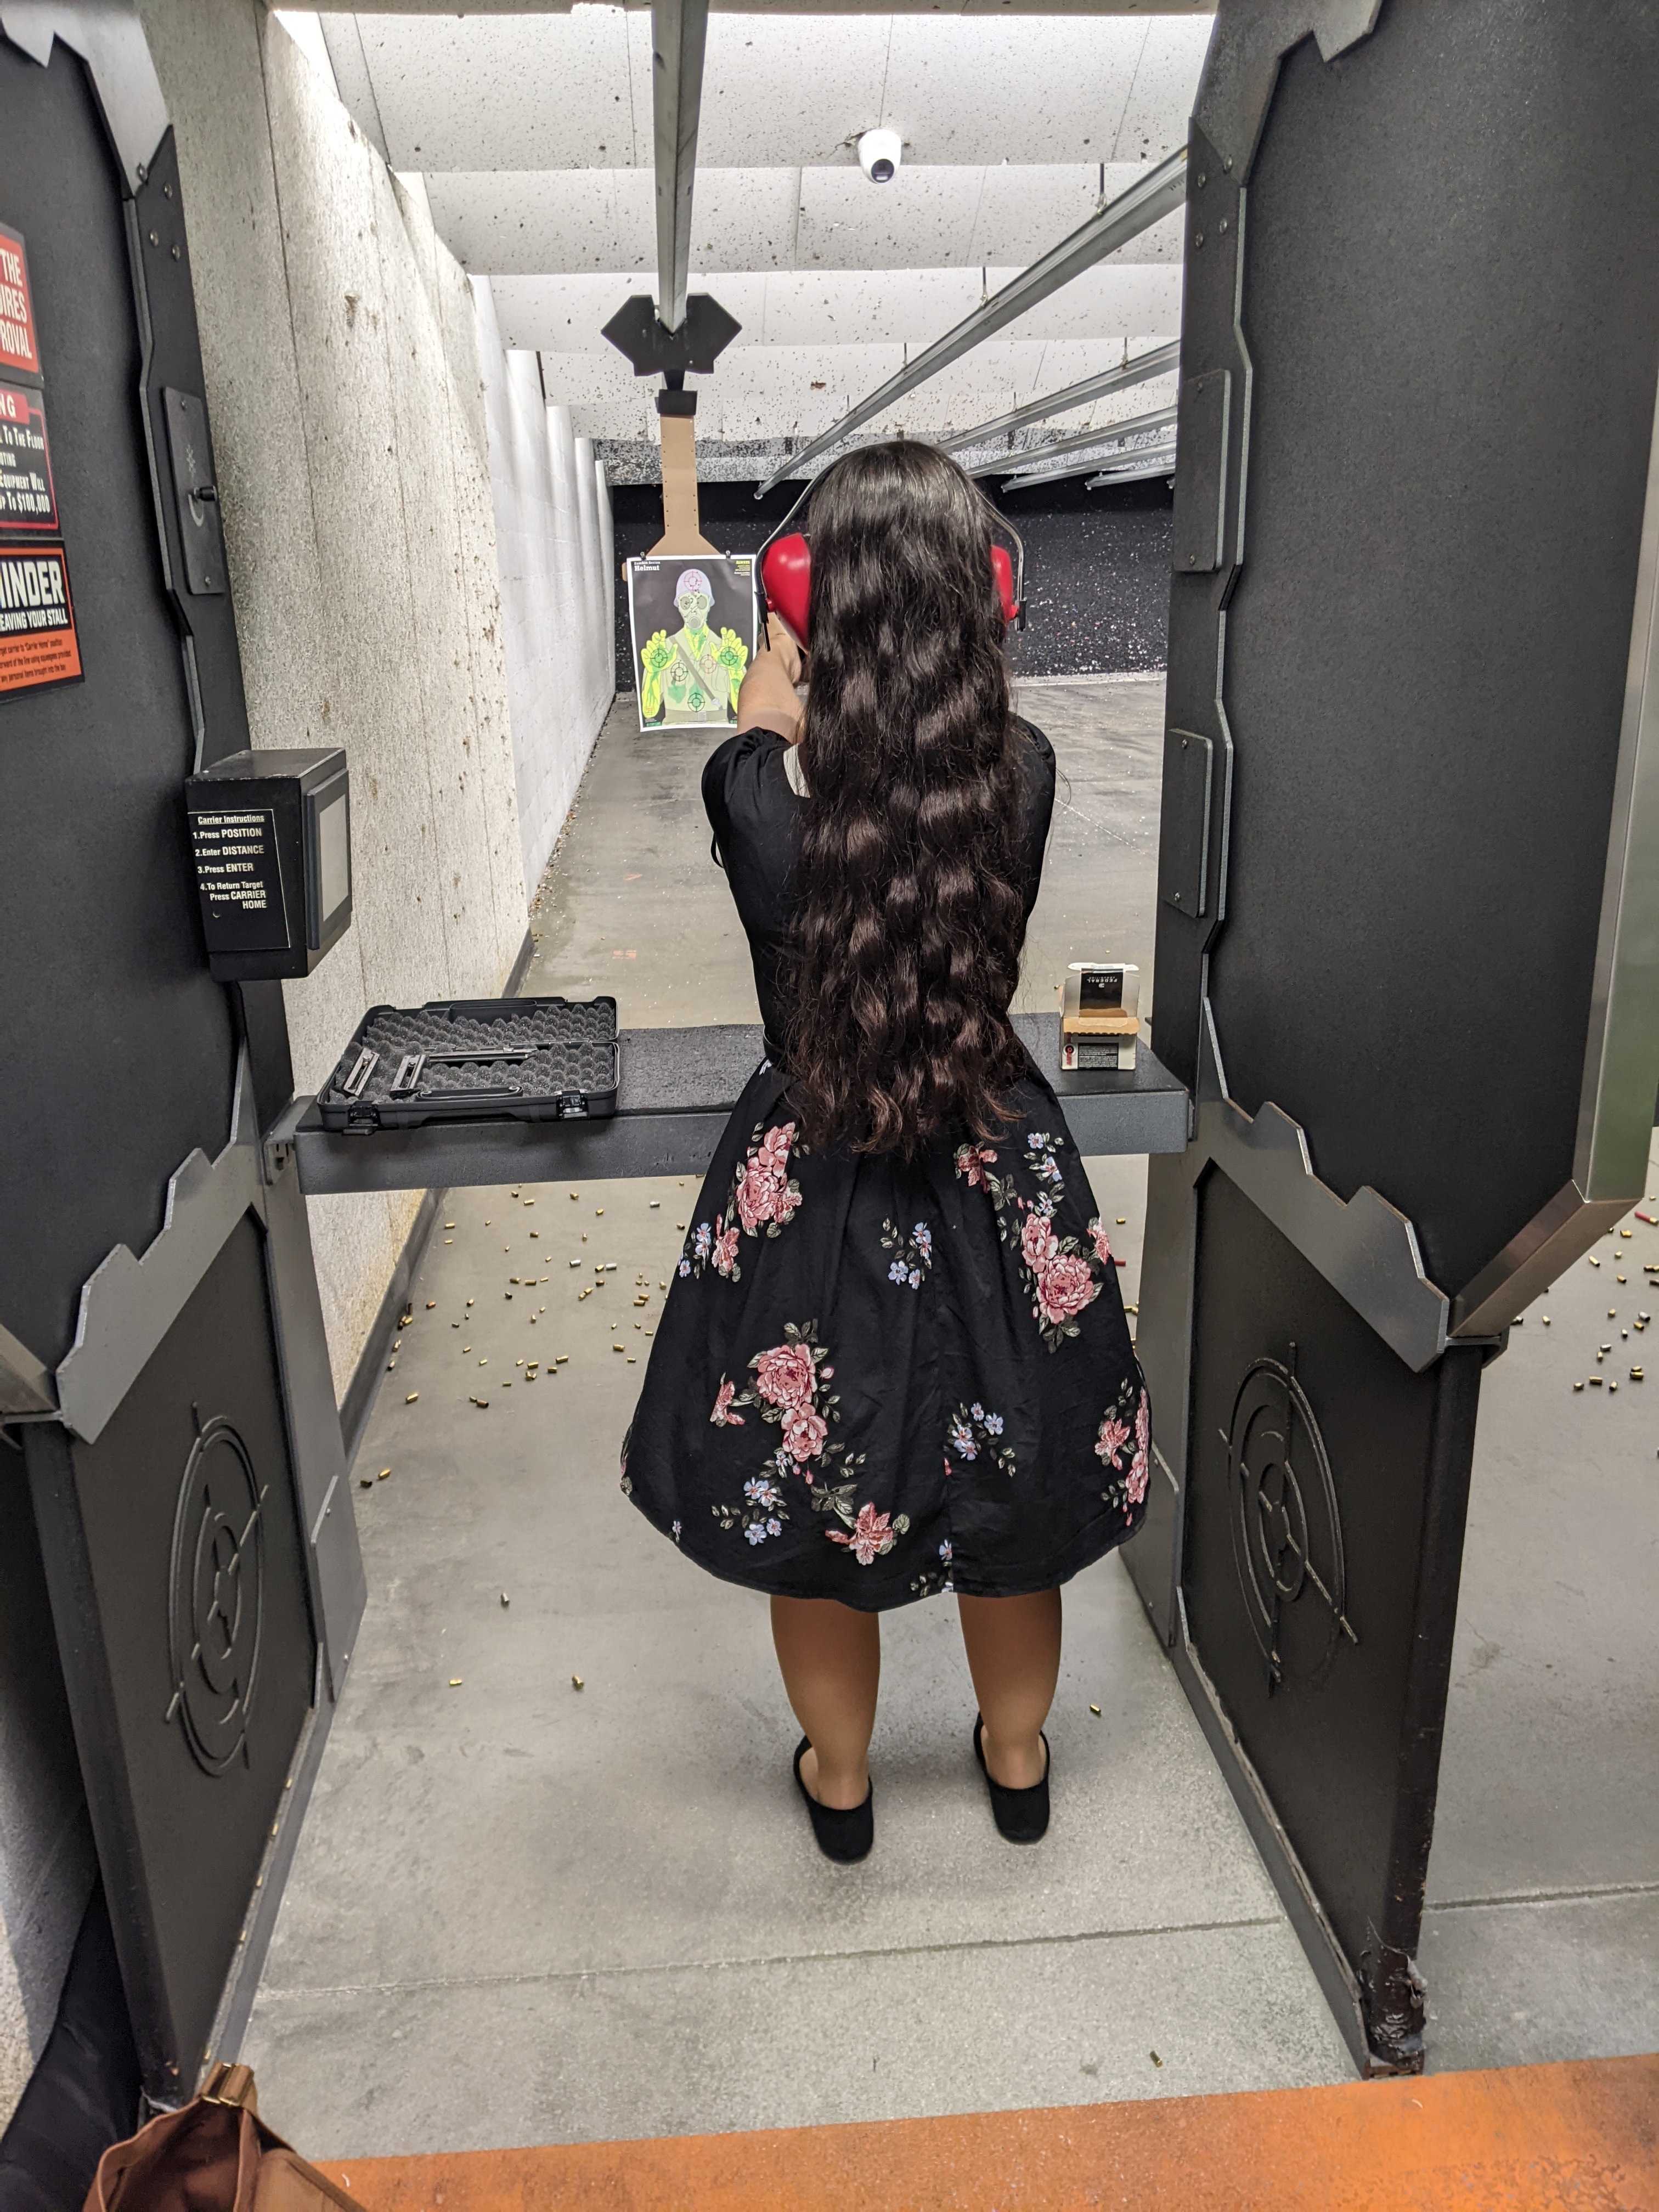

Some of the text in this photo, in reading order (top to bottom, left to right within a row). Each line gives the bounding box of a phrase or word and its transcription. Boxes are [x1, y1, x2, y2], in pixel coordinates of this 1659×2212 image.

[0, 249, 22, 287] THE
[16, 492, 50, 515] $100,000
[26, 610, 47, 628] YOUR
[47, 608, 68, 625] STALL
[223, 814, 264, 823] Instructions
[221, 828, 262, 838] POSITION
[222, 845, 264, 855] DISTANCE
[225, 862, 253, 872] ENTER
[200, 882, 216, 890] 4.To
[241, 881, 263, 889] Target
[231, 890, 266, 900] CARRIER
[242, 900, 267, 909] HOME
